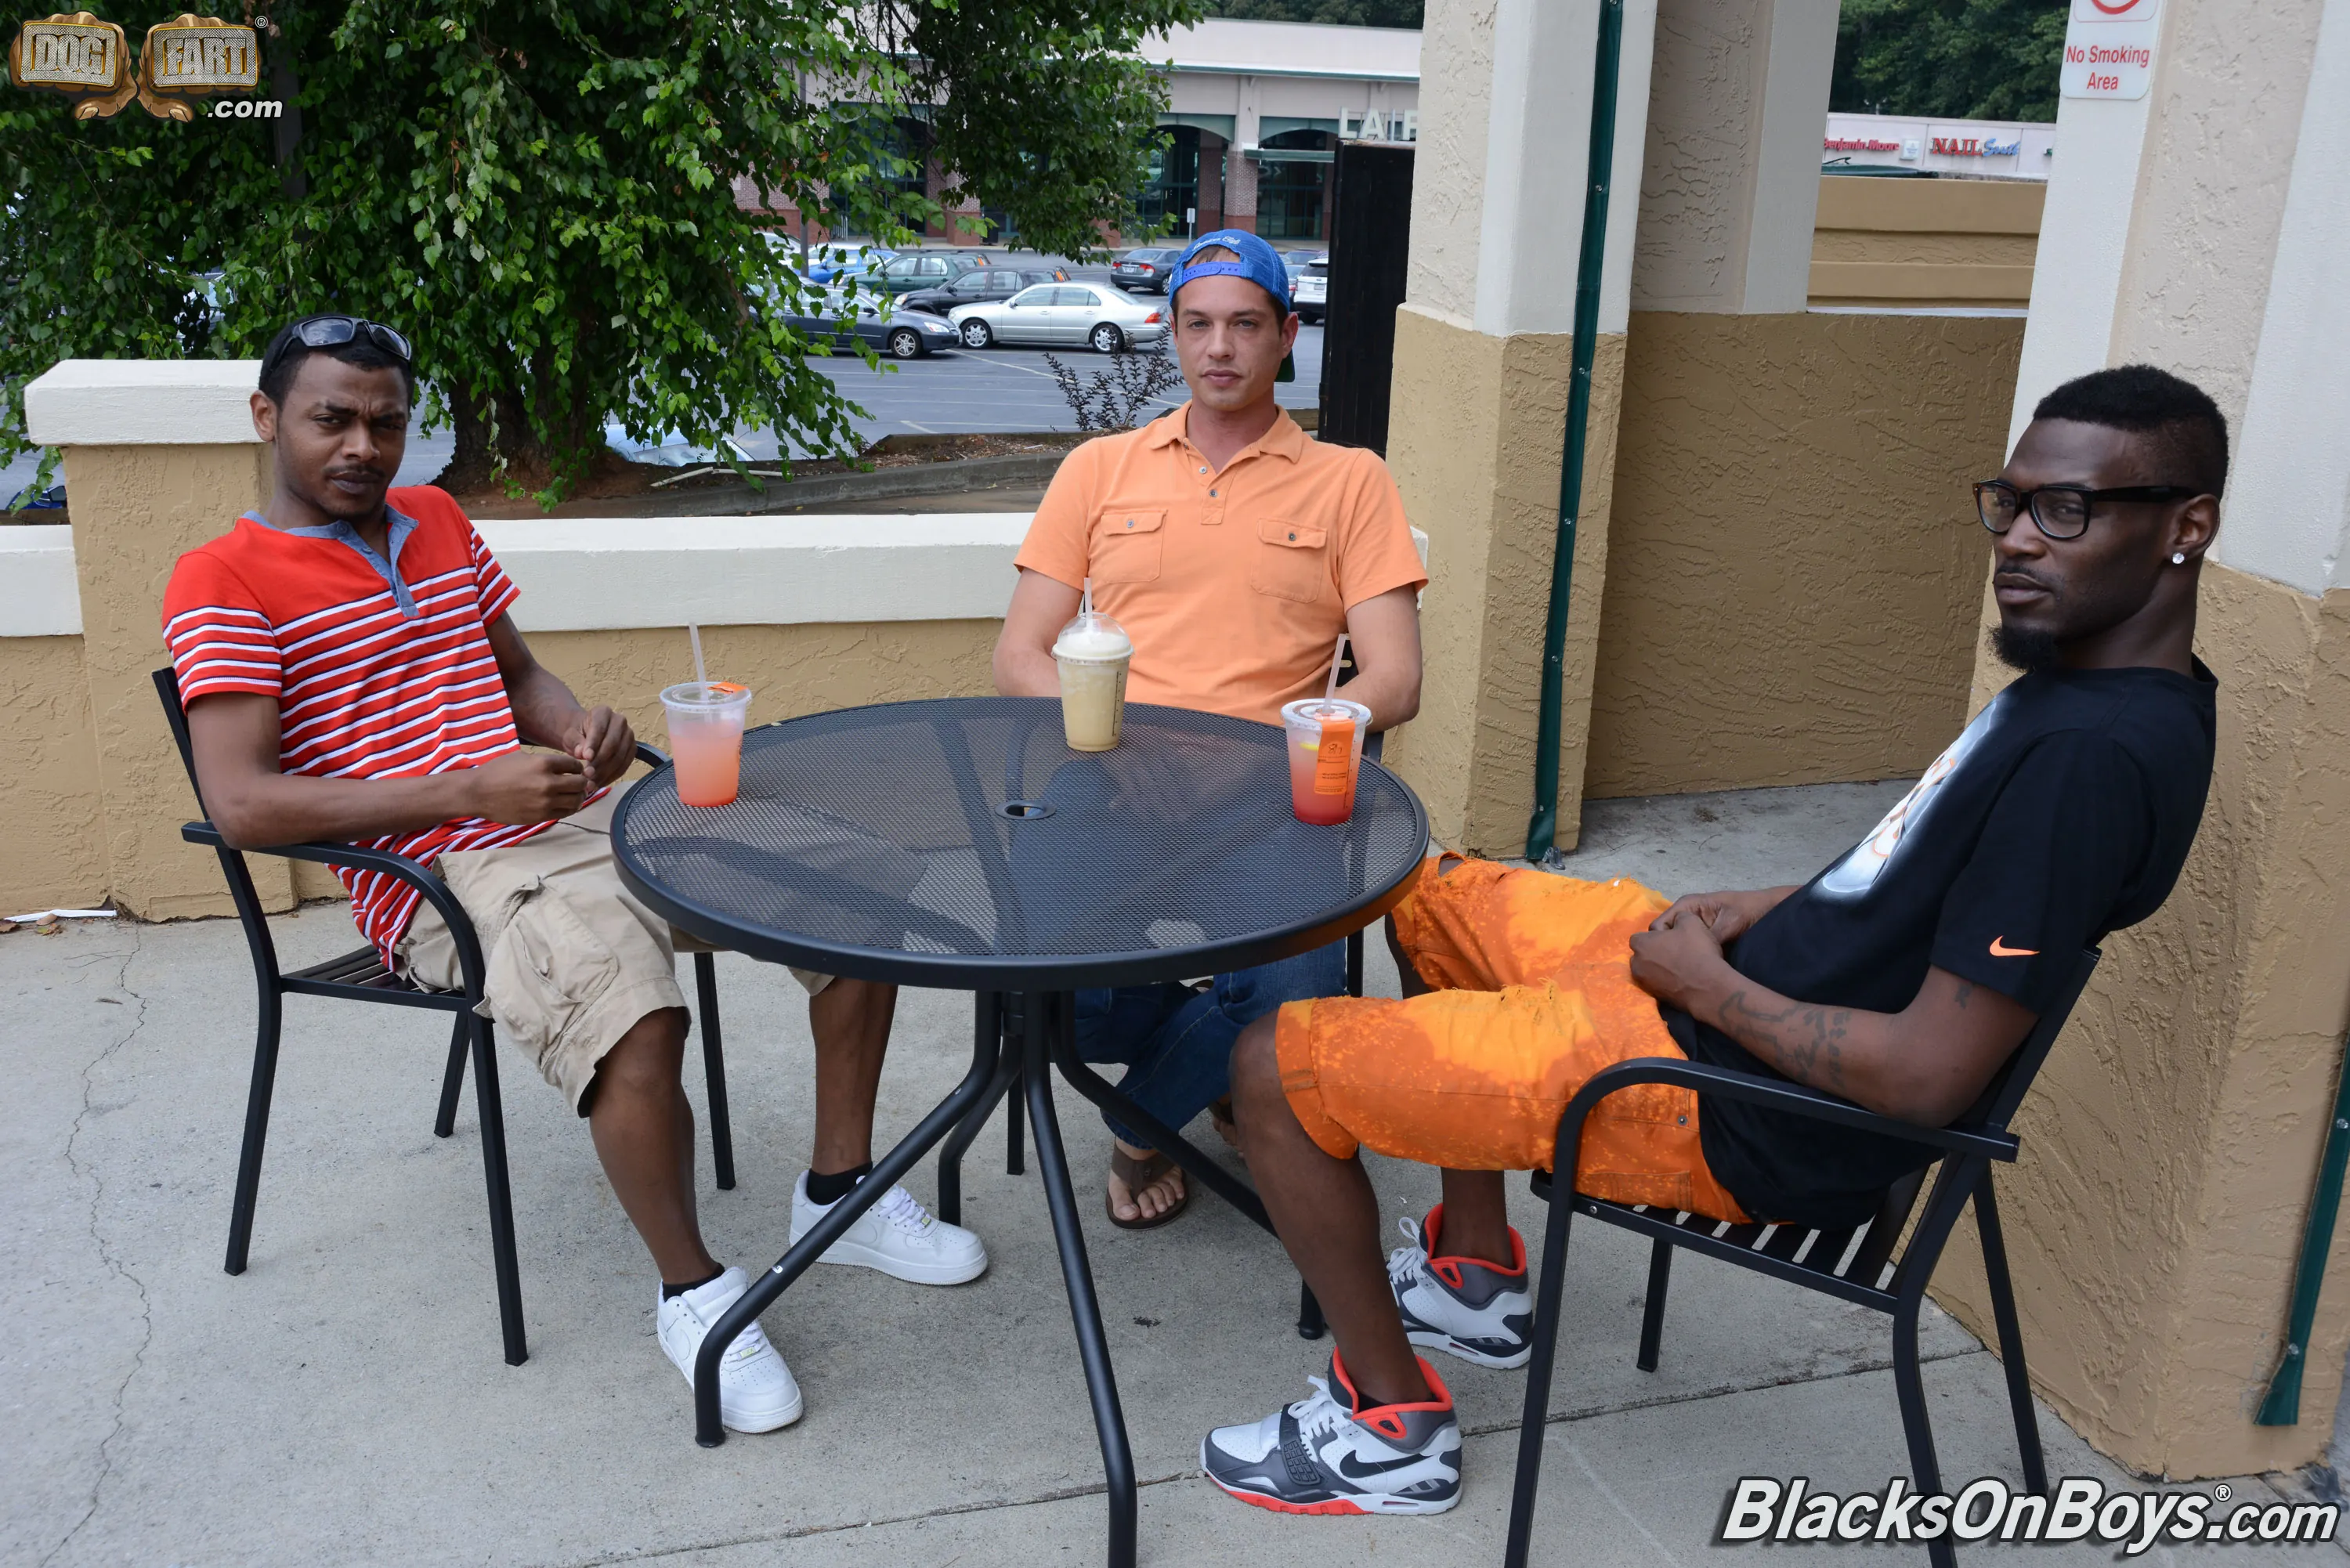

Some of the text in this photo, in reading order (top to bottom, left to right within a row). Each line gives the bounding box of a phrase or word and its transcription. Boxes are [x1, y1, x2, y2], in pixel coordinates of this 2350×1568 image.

[2066, 45, 2149, 68] No Smoking
[2087, 71, 2119, 90] Area
[1931, 138, 1983, 156] NAIL
